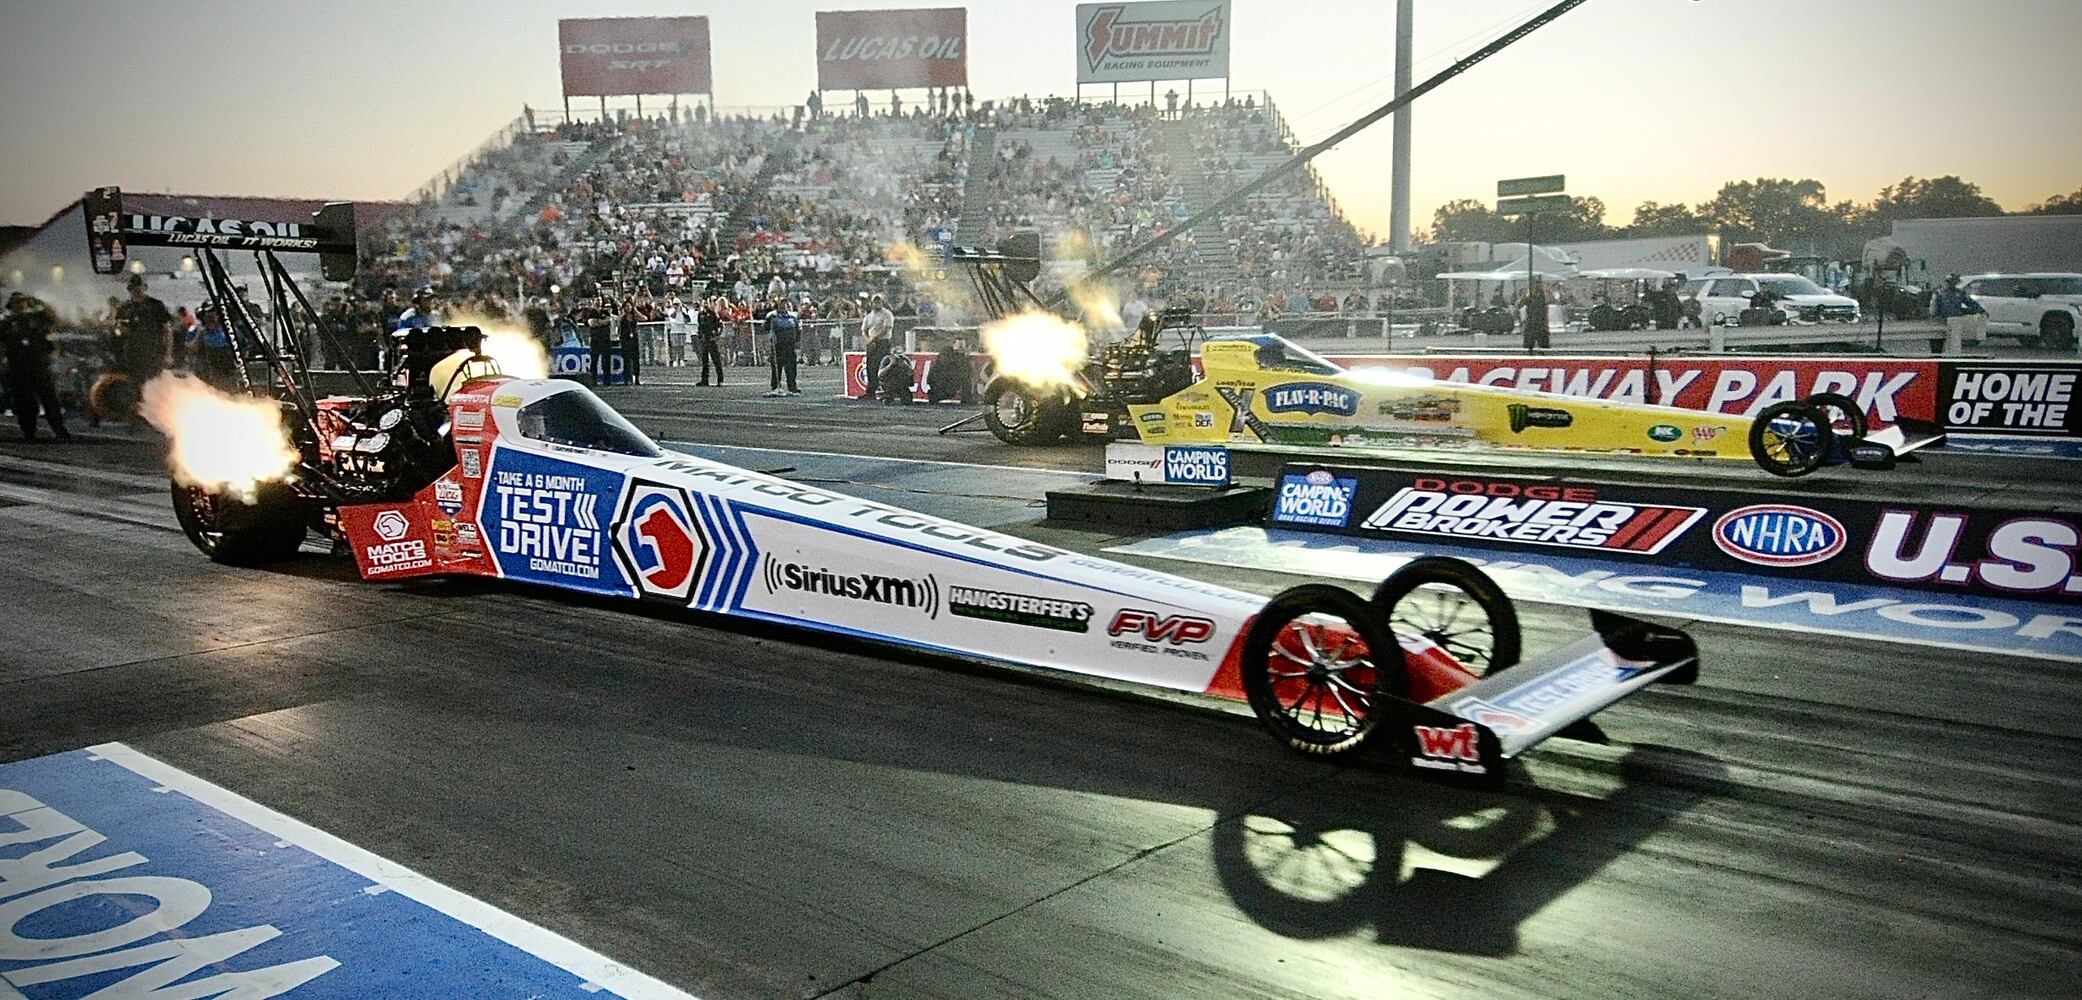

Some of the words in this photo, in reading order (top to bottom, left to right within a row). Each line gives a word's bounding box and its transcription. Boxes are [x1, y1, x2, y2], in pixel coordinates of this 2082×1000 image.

[823, 35, 918, 61] LUCAS
[918, 35, 961, 59] OIL
[1087, 8, 1221, 66] SUMMIT
[1104, 62, 1144, 70] RACING
[1148, 60, 1211, 69] EQUIPMENT
[168, 233, 207, 245] LUCAS
[210, 235, 230, 245] OIL
[241, 236, 258, 246] IT
[259, 236, 317, 249] WORKS!
[1406, 366, 1702, 409] ACEWAY
[1952, 372, 2077, 402] HOME
[1948, 401, 1993, 424] OF
[2003, 402, 2068, 427] THE
[1167, 450, 1226, 465] CAMPING
[497, 471, 523, 486] TAKE
[525, 474, 533, 487] A
[535, 474, 544, 488] 6
[545, 475, 585, 492] MONTH
[1168, 463, 1227, 480] WORLD
[1283, 483, 1350, 502] CAMPING
[1414, 477, 1598, 502] DODGE
[496, 485, 572, 526] TEST
[1281, 497, 1347, 517] WORLD
[1396, 493, 1636, 530] POWER
[500, 520, 601, 566] DRIVE!
[849, 503, 1070, 562] TOOLS
[1395, 514, 1617, 546] BROKERS
[1732, 515, 1826, 552] NHRA
[367, 540, 425, 557] MATCO
[368, 549, 427, 565] TOOLS
[368, 559, 433, 575] GOMATCO.COM
[530, 557, 600, 579] GOMATCO.COM
[951, 588, 1090, 621] HANGSTERFER'S
[1109, 609, 1216, 645] FVP
[1414, 723, 1480, 761] wt
